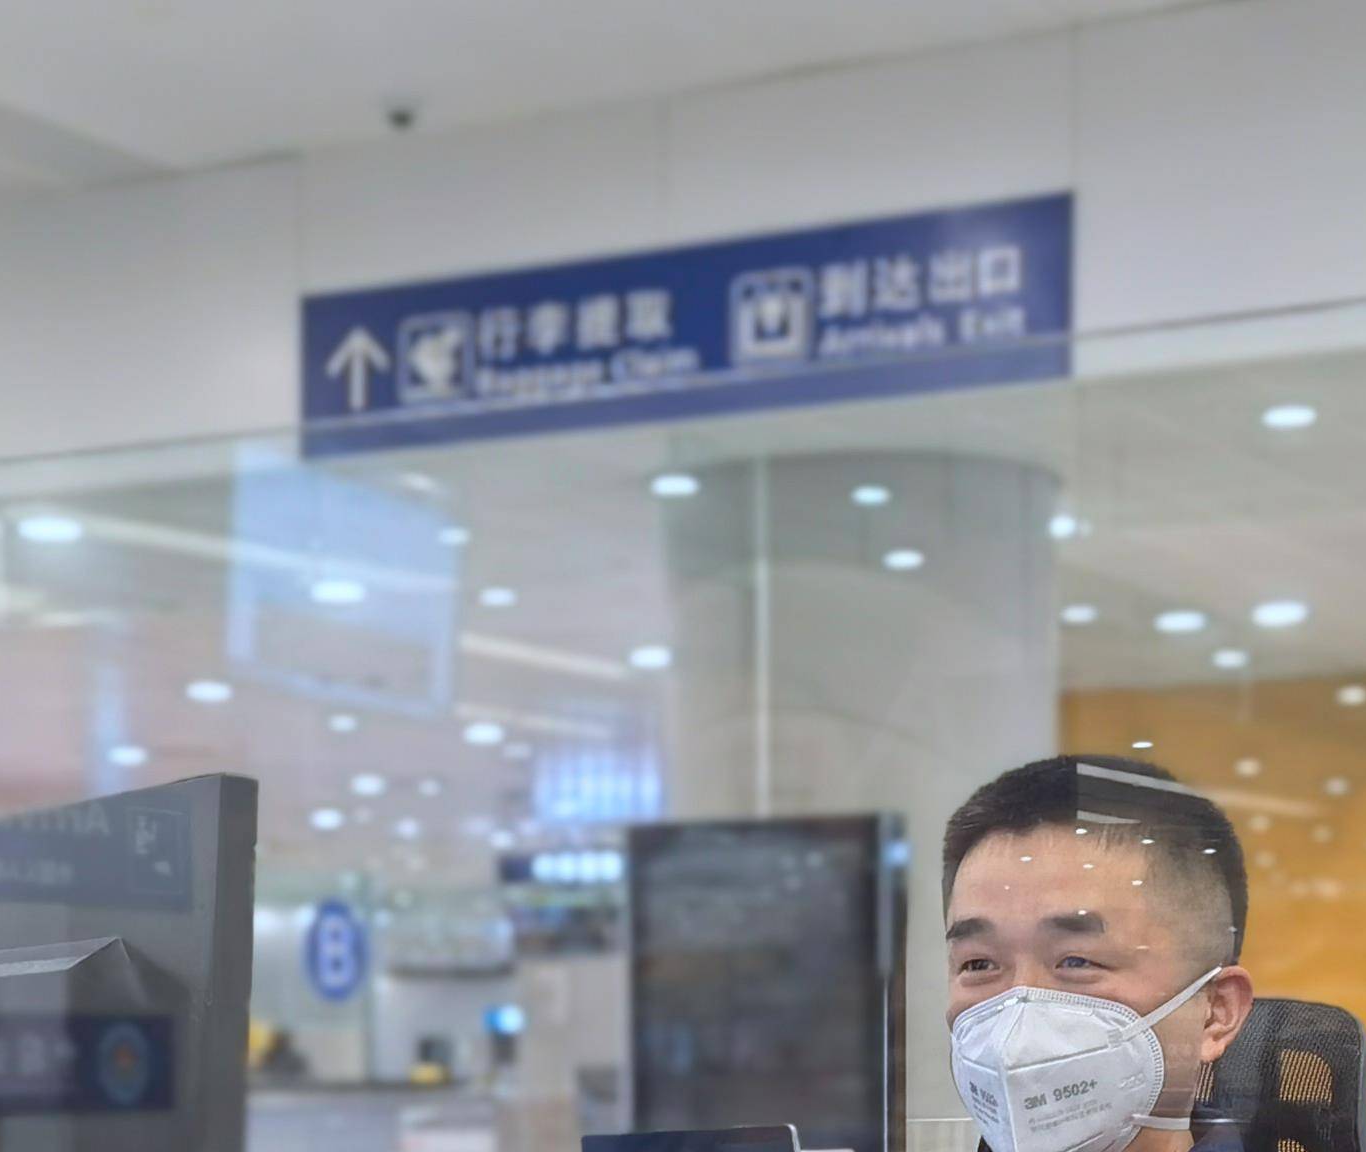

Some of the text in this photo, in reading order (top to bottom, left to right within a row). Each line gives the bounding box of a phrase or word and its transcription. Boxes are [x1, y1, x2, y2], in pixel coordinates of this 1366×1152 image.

[819, 247, 1023, 318] 到达出口
[478, 290, 672, 361] 行李提取
[1024, 1079, 1098, 1111] 3M 9502+
